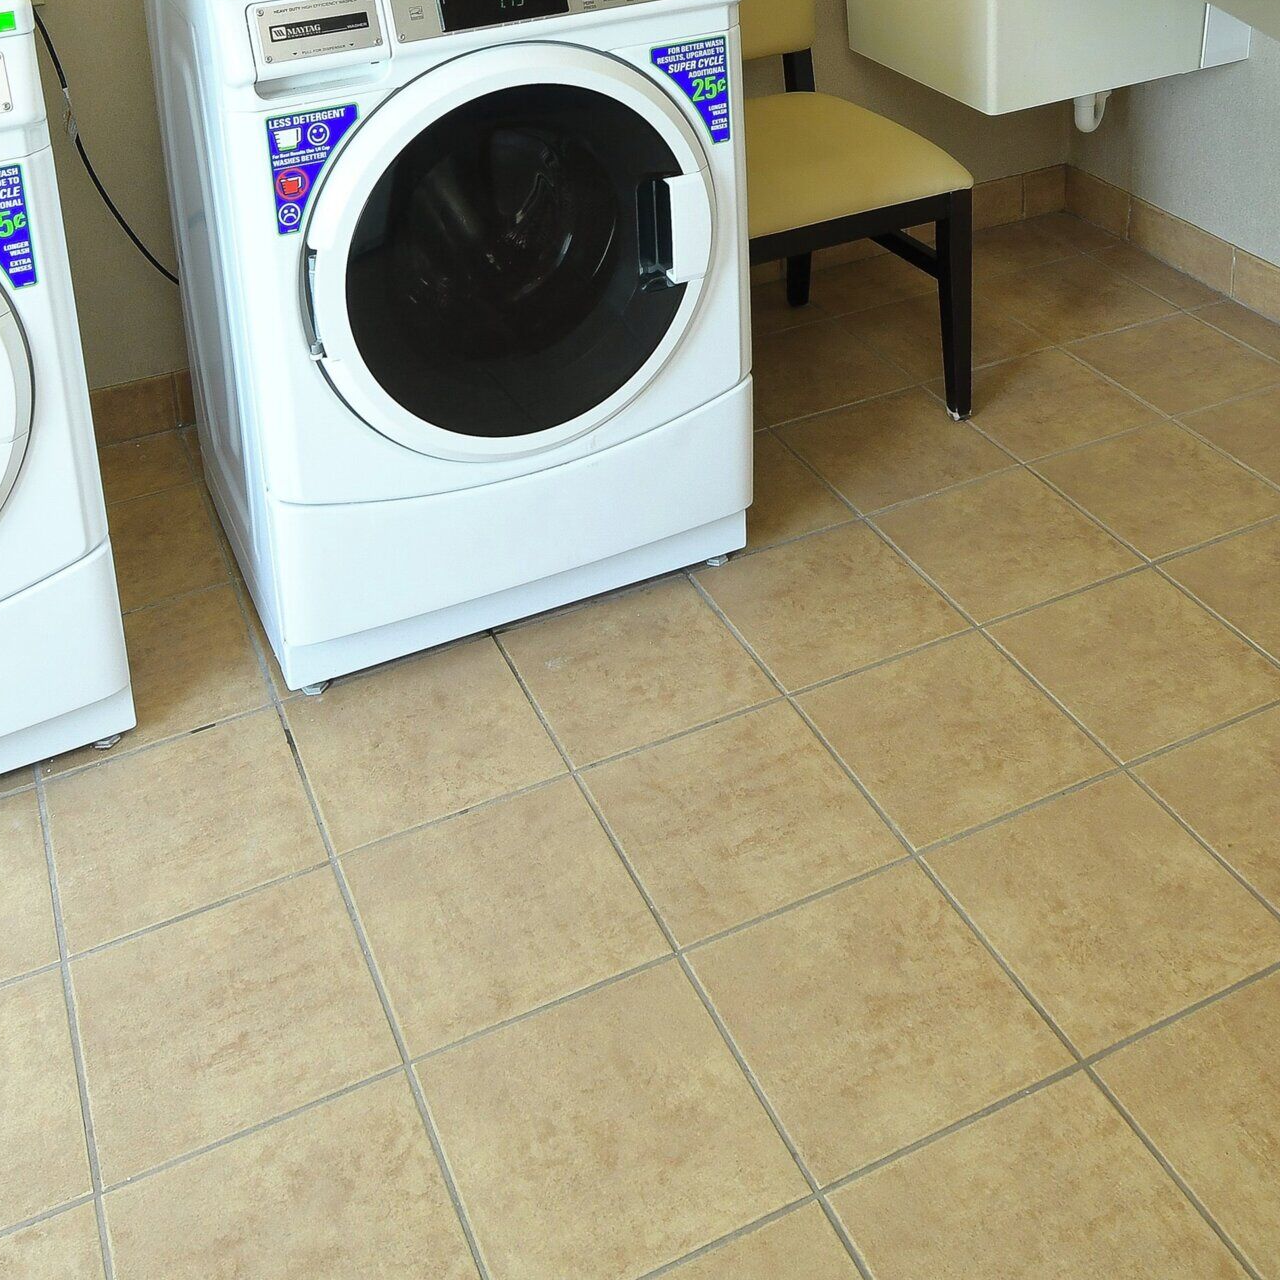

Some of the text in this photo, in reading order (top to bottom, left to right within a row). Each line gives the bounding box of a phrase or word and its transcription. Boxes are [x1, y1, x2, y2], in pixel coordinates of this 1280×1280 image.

[286, 24, 321, 36] MAYTAG
[668, 39, 724, 55] FOR BETTER WASH
[657, 54, 686, 65] RESULTS,
[686, 49, 716, 60] UPGRADE
[668, 55, 725, 74] SUPER CYCLE
[688, 66, 725, 79] ADDITIONAL
[691, 76, 727, 102] 25¢
[708, 103, 727, 111] LONGER
[268, 108, 345, 129] LESS DETERGENT
[272, 151, 327, 167] WASHES BETTER!
[8, 176, 20, 185] TO
[3, 240, 29, 252] LONGER
[9, 247, 29, 257] WASH
[9, 257, 32, 267] EXTRA
